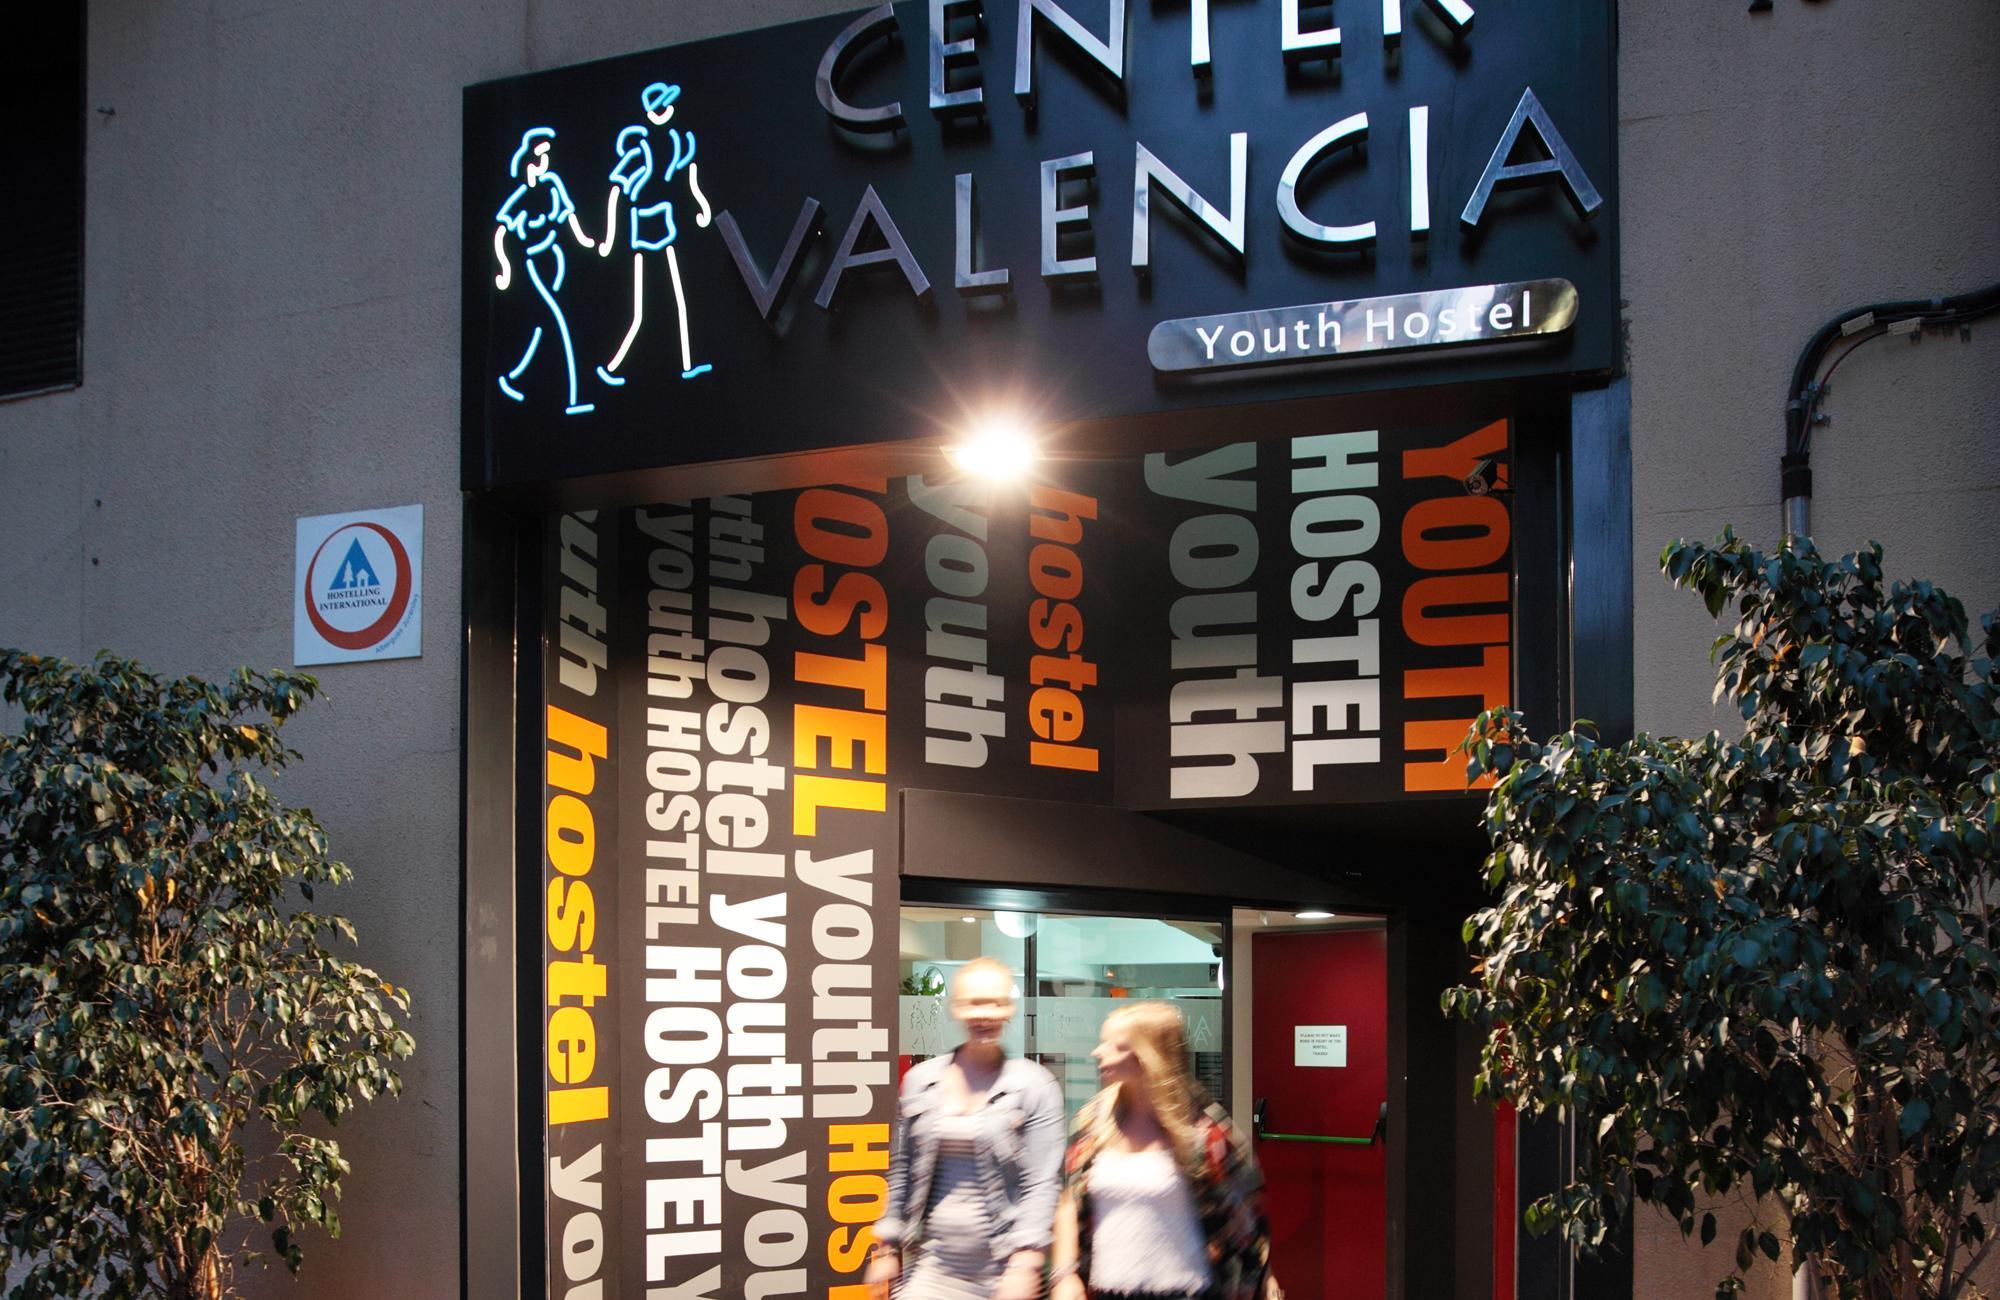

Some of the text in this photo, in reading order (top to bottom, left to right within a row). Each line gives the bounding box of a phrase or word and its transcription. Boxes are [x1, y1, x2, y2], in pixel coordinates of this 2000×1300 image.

[715, 86, 1604, 320] VALENCIA
[1196, 290, 1532, 360] Youth Hostel
[319, 597, 388, 611] INTERNATIONAL
[326, 587, 381, 601] HOSTELLING
[559, 509, 608, 697] uth
[635, 499, 706, 940] youth HOSTEL
[705, 585, 788, 878] hostel
[793, 477, 888, 837] OSTEL
[906, 474, 1006, 769] youth
[1028, 484, 1099, 772] hostel
[1144, 441, 1286, 800] youth
[1290, 430, 1382, 792] HOSTEL
[1401, 418, 1512, 793] YOUTH
[546, 704, 609, 1125] hostel
[709, 892, 804, 1151] youth
[794, 843, 891, 1119] youth
[644, 945, 724, 1281] HOSTEL
